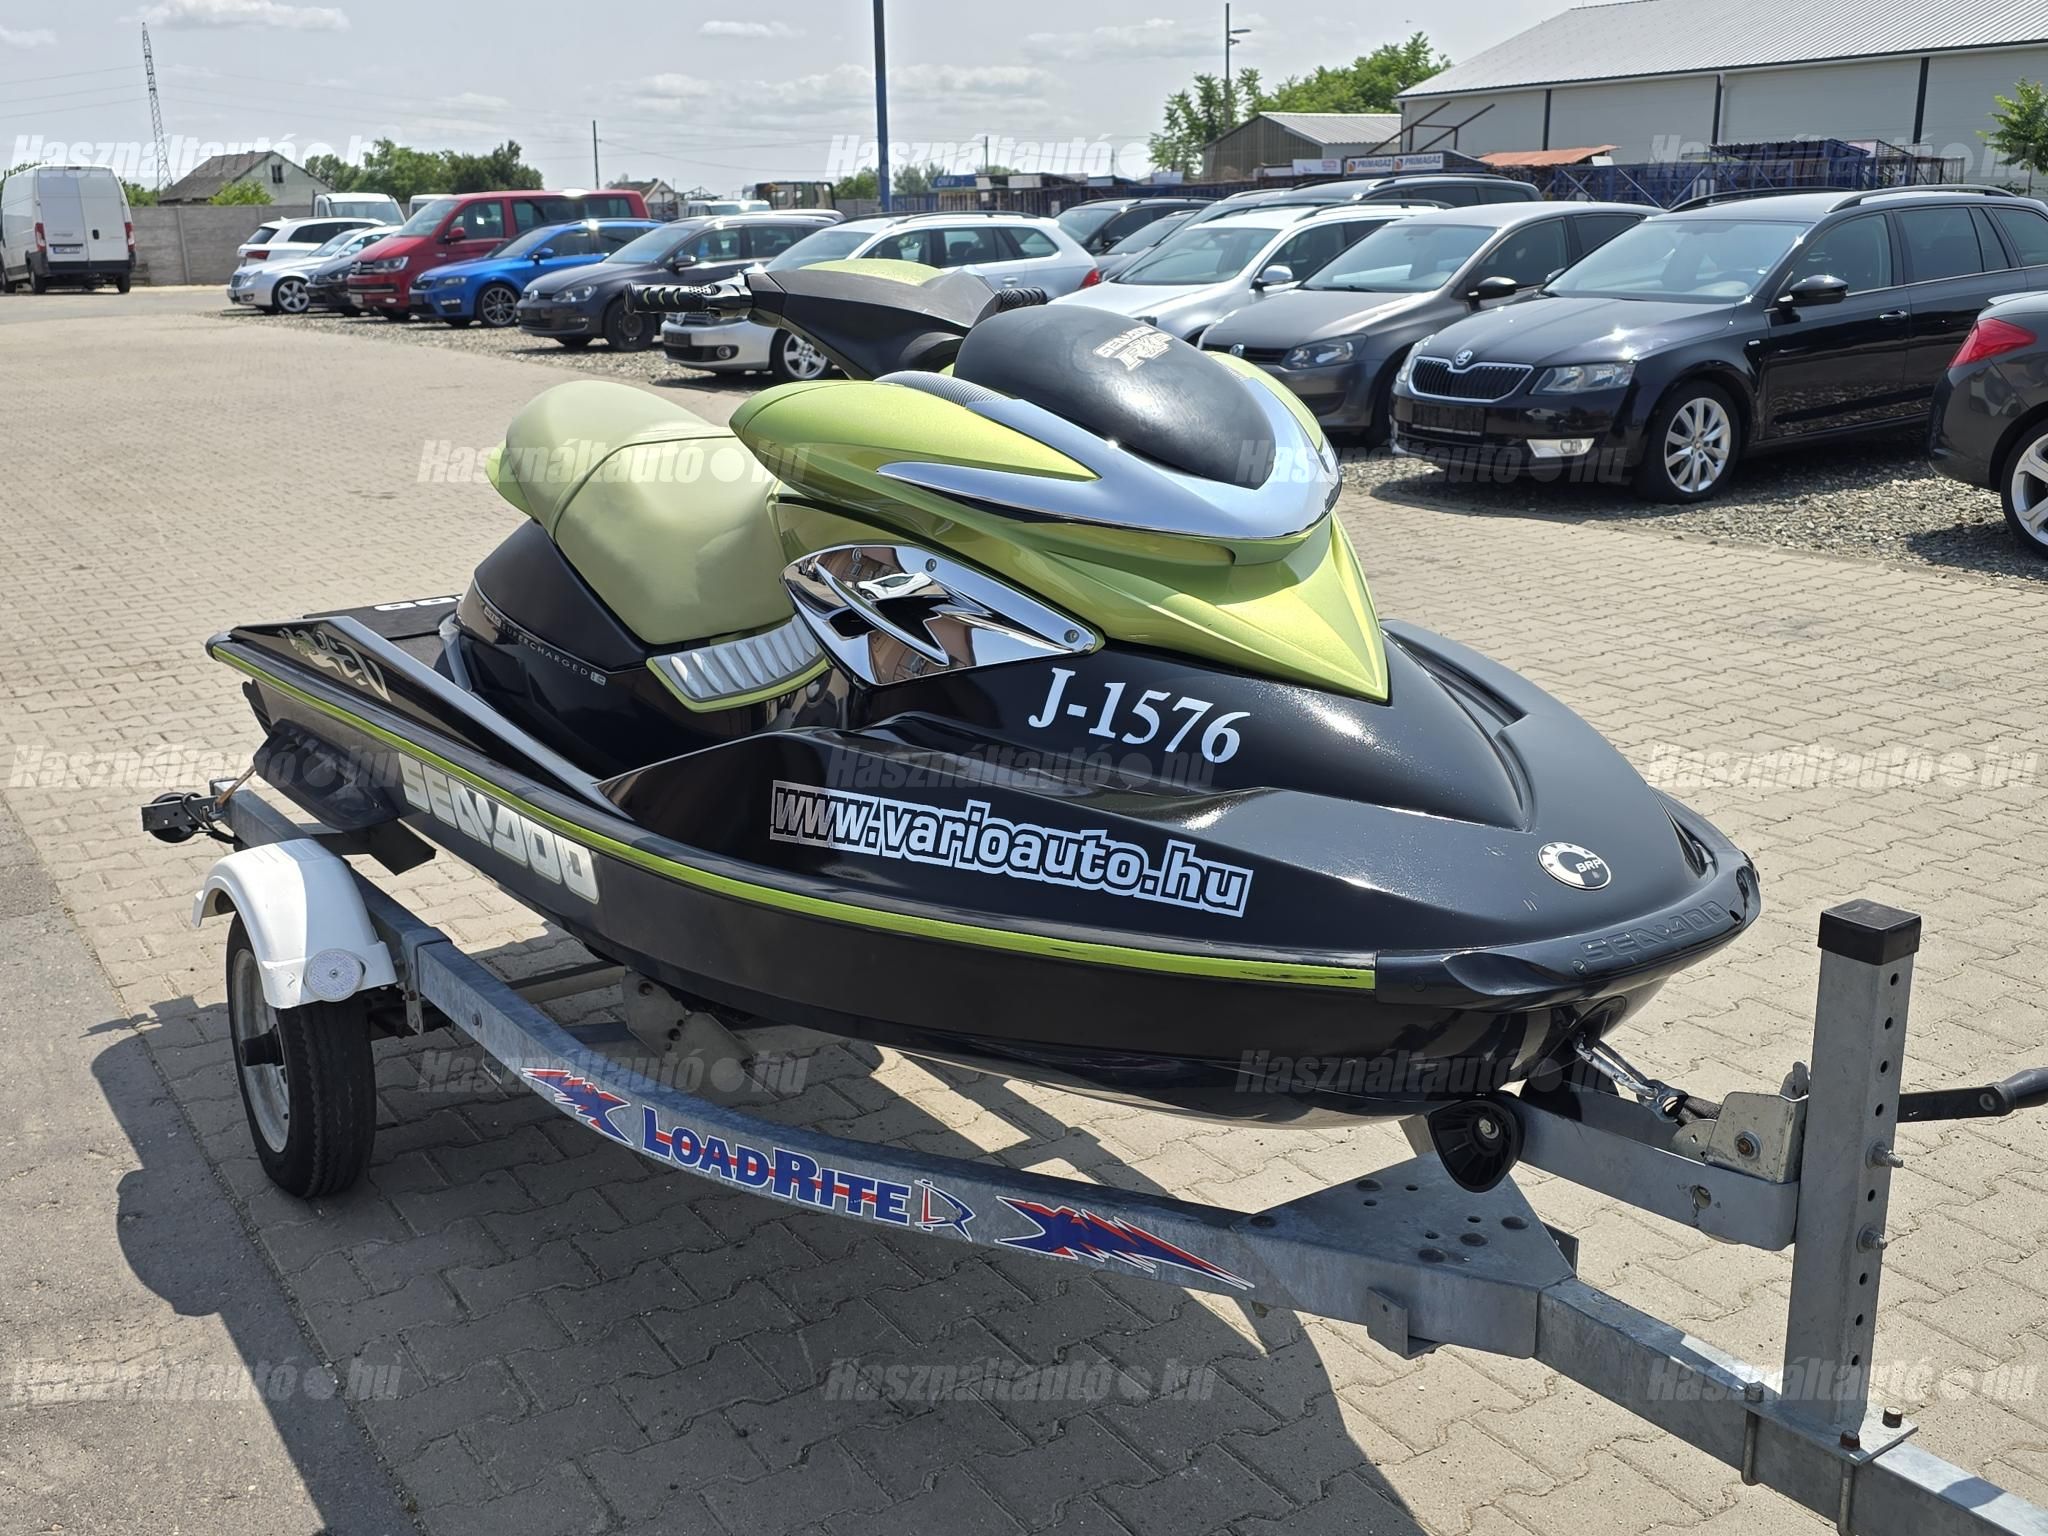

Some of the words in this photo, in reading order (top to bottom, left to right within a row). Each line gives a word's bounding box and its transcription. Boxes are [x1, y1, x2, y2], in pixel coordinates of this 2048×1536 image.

[501, 623, 589, 677] SUPERCHARGED
[1028, 667, 1252, 764] J-1576
[769, 780, 1254, 918] www.varioauto.hu
[1575, 858, 1602, 873] BRP
